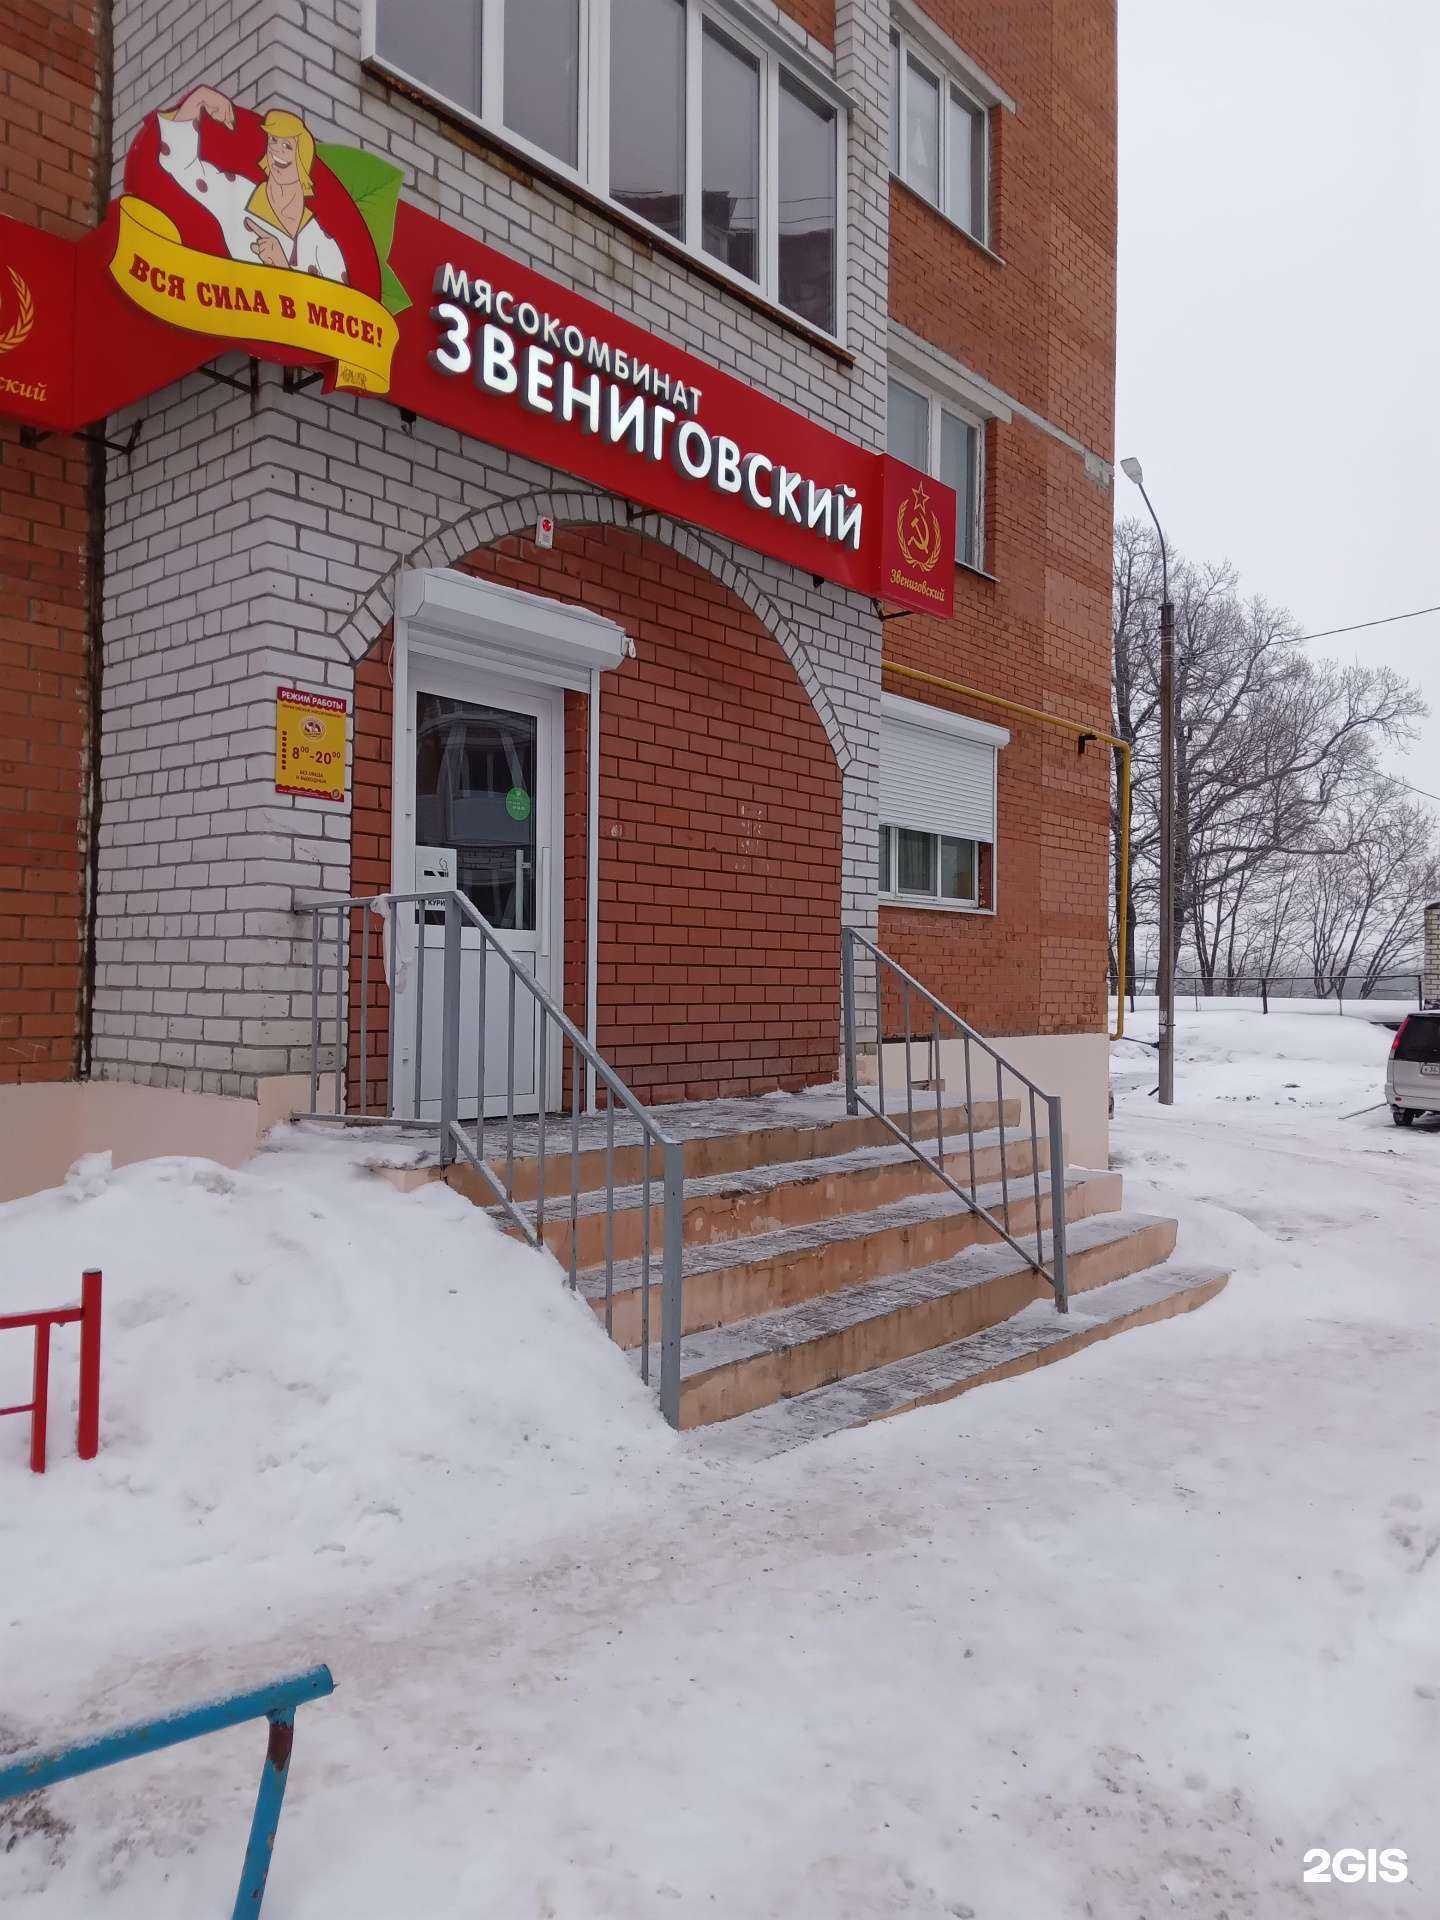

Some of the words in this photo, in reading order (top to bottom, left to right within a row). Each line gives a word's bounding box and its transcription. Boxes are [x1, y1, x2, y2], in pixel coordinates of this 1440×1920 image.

[129, 253, 186, 301] ВСЯ
[196, 281, 270, 315] СИЛА
[279, 294, 296, 319] В
[307, 301, 383, 347] МЯСЕ!
[438, 262, 702, 415] МЯСОКОМБИНАТ
[432, 302, 864, 551] ЗВЕНИГОВСКИЙ
[889, 568, 945, 602] Звениговский
[281, 690, 311, 704] РЕЖИМ
[312, 697, 343, 710] РАБОТЫ
